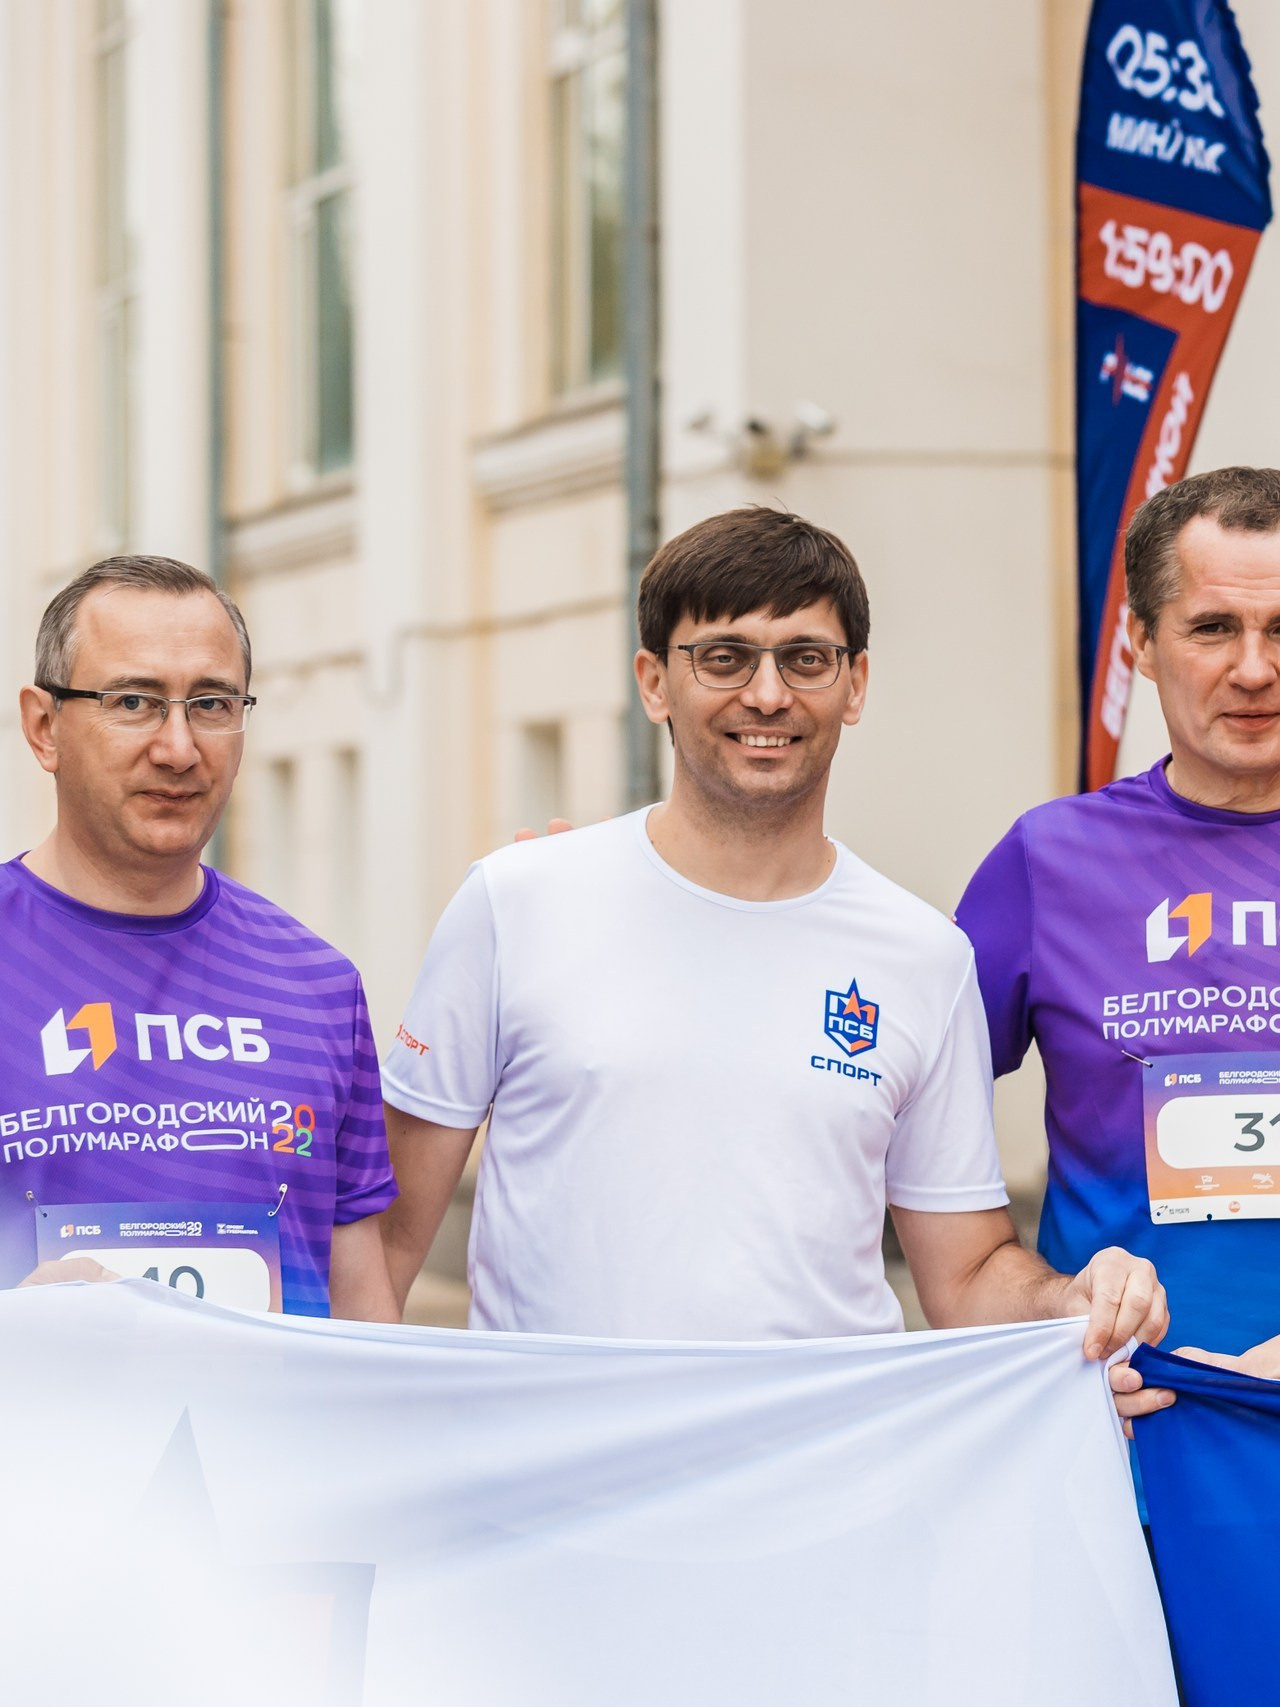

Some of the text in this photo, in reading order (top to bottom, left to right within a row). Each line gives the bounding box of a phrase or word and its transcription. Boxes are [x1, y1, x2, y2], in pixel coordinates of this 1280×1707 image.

[135, 1013, 270, 1063] ПСБ
[829, 1016, 873, 1040] ПСБ
[811, 1055, 882, 1087] СПОРТ
[1179, 1074, 1201, 1084] ПСБ
[0, 1097, 266, 1136] БЕЛГОРОДСКИЙ
[3, 1128, 268, 1163] ПОЛУМАРАФОН
[76, 1225, 101, 1235] ПСБ
[120, 1222, 186, 1230] БЕЛГОРОДСКИЙ
